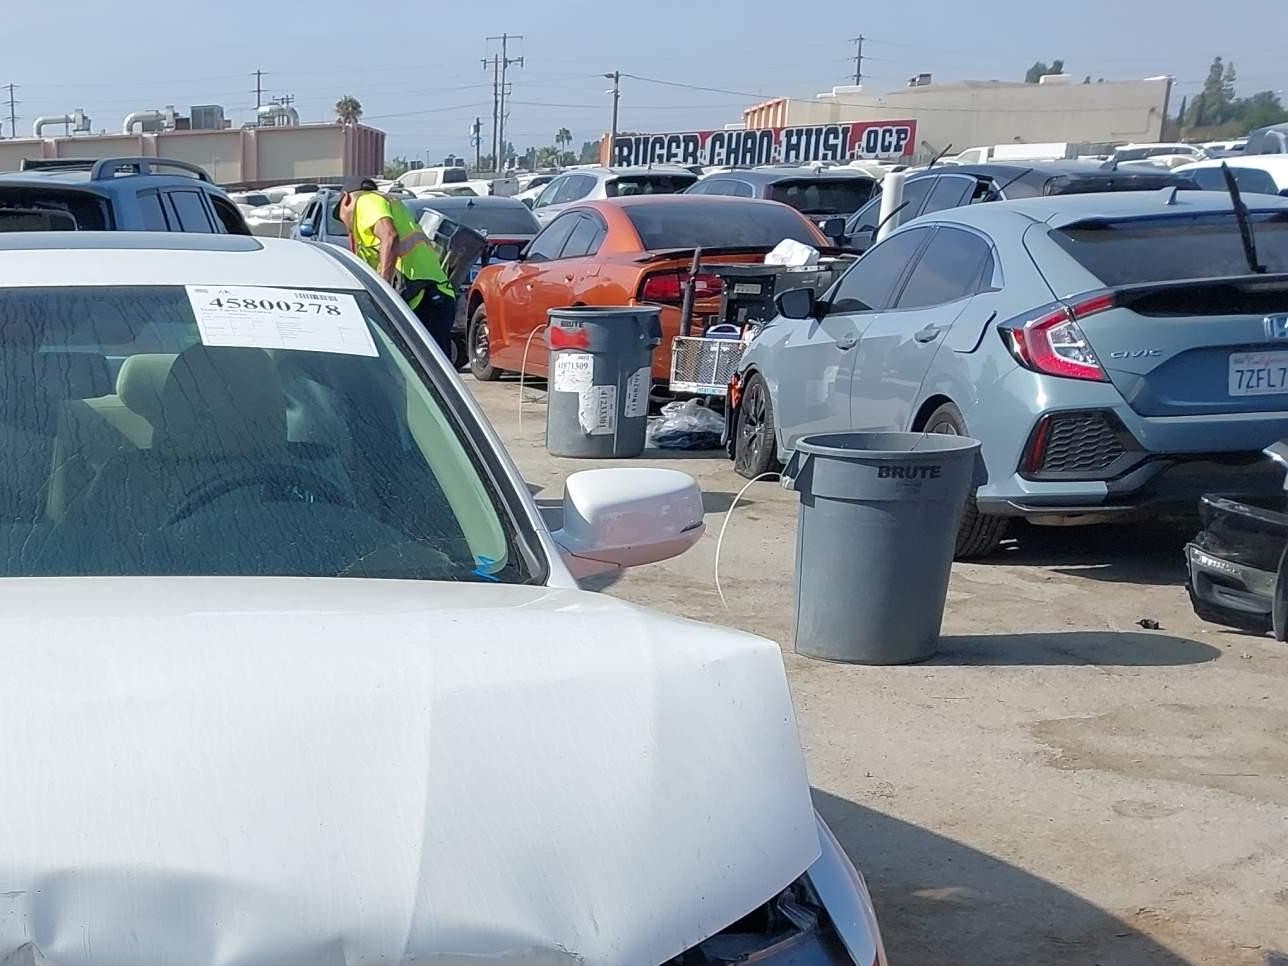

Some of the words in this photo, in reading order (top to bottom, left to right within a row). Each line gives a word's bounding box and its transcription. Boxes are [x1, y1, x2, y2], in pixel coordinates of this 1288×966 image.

[863, 128, 910, 153] OCP
[209, 298, 342, 316] 45800278
[1110, 349, 1162, 359] CIVIC
[878, 465, 942, 479] BRUTE
